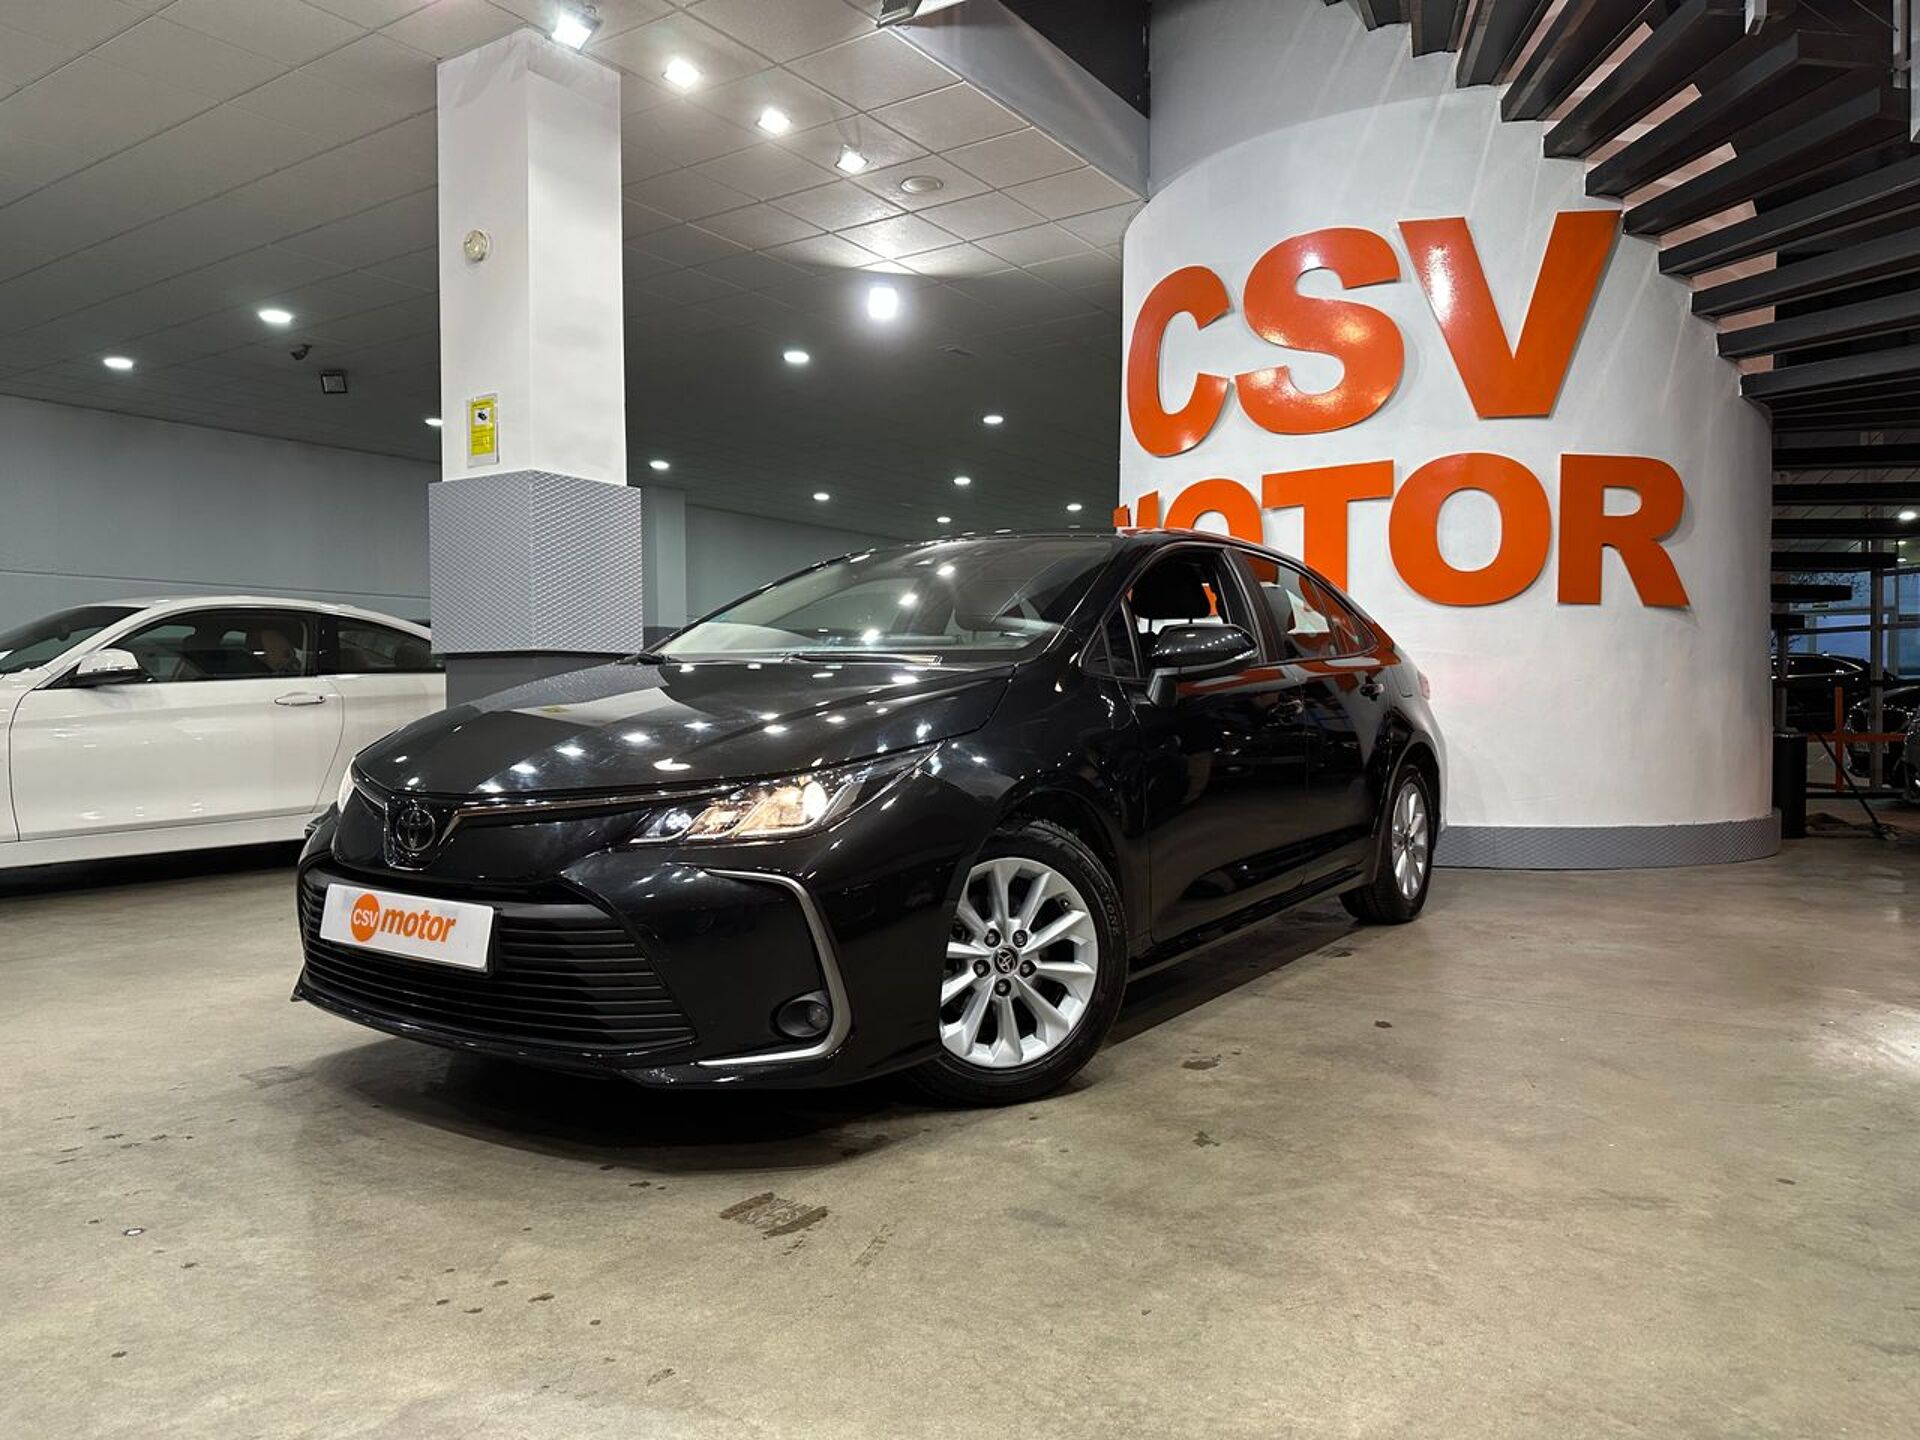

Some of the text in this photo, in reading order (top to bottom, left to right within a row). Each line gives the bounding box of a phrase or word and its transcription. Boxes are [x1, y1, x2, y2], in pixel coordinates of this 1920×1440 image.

[1127, 210, 1622, 456] CSV
[1113, 452, 1690, 607] OTOR
[353, 908, 456, 942] CSV motor
